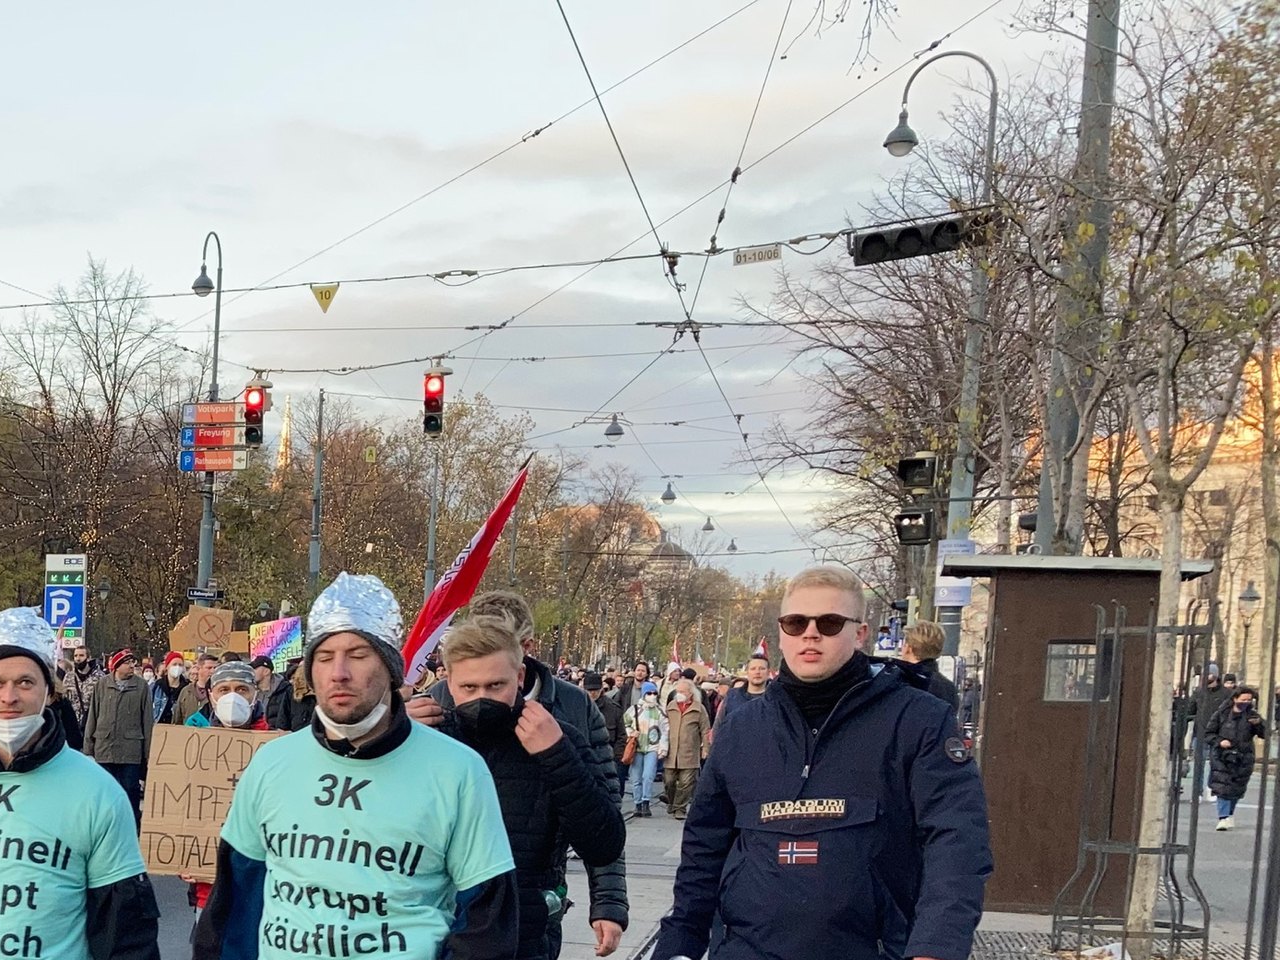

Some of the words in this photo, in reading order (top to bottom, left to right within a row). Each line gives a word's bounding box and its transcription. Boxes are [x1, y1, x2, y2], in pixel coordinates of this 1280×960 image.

[735, 248, 779, 264] 01-10/06
[319, 290, 331, 300] 10
[197, 405, 234, 414] Votivpark
[198, 428, 231, 438] Freyung
[255, 625, 275, 637] NEIN
[280, 619, 299, 633] ZUR
[156, 731, 266, 773] LOCKD
[150, 781, 233, 822] IMPF
[314, 773, 373, 811] 3K
[761, 798, 846, 819] NAPAPIJRI
[142, 831, 219, 869] TOTAL
[260, 823, 425, 877] kriminell
[262, 916, 408, 958] käuflich
